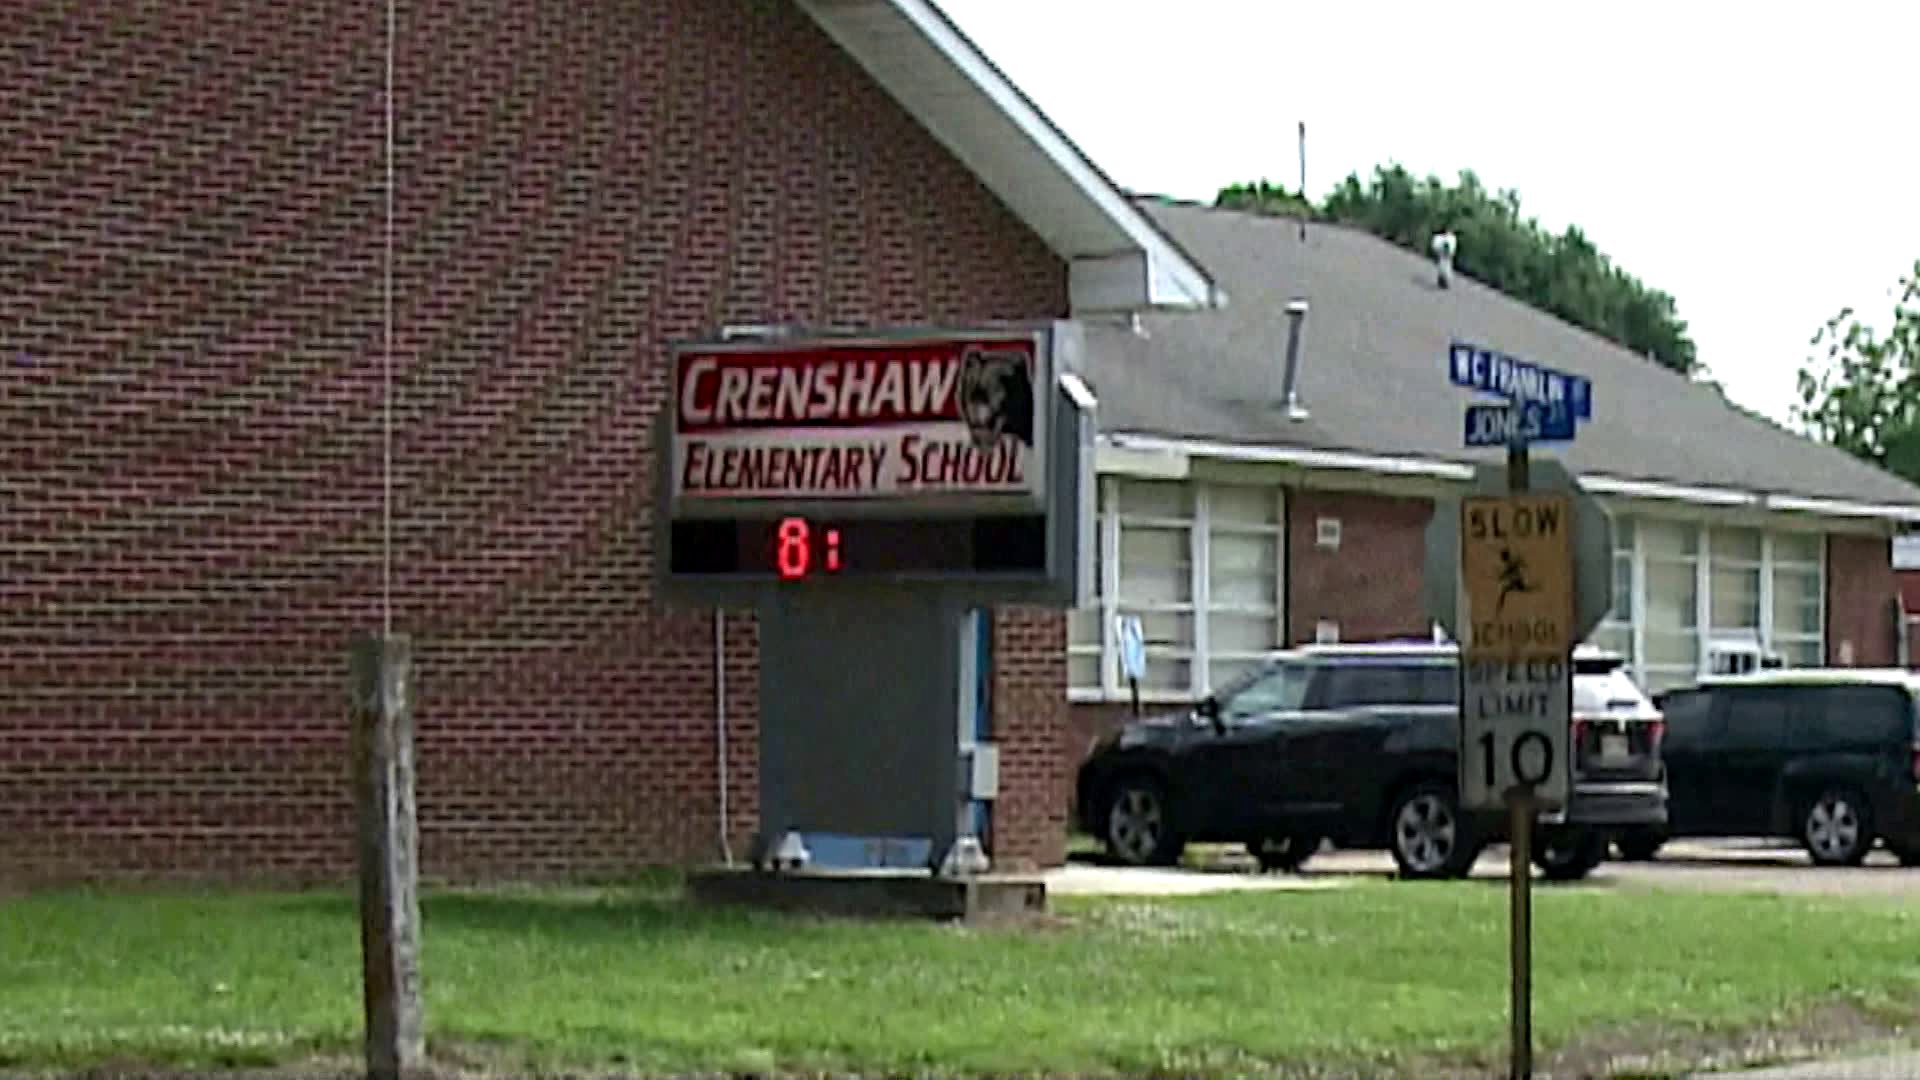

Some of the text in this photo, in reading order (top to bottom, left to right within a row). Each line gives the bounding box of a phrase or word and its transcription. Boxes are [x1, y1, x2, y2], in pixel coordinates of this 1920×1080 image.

[682, 358, 958, 423] CRENSHAW
[1468, 407, 1541, 442] JONES
[682, 434, 1024, 490] ELEMENTARY SCHOOL
[1470, 505, 1560, 539] SLOW
[1478, 694, 1548, 719] LIMIT
[1476, 730, 1554, 787] 10
